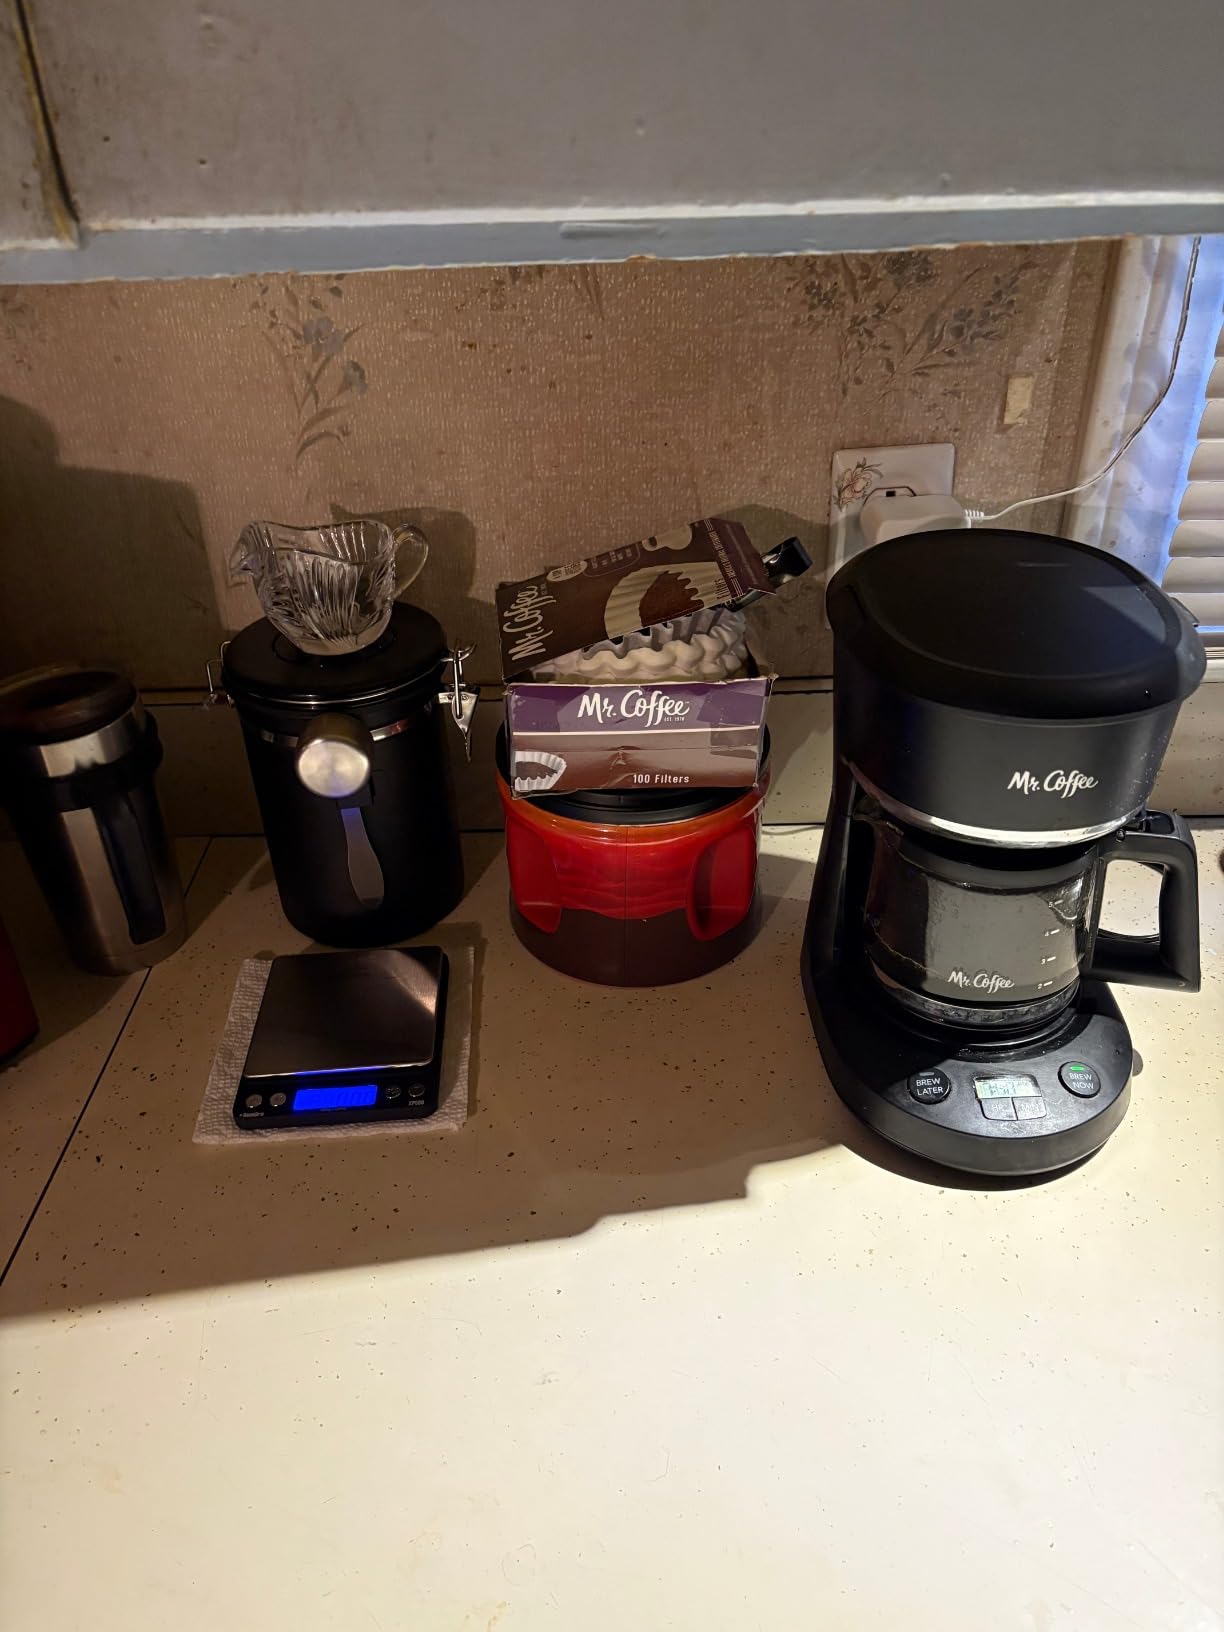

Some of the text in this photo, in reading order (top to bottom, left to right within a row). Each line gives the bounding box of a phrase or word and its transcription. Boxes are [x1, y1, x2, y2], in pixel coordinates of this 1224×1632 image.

[503, 586, 556, 661] Mr. Coffee
[577, 690, 690, 727] Mr. Coffee
[632, 773, 689, 784] 100 Filters
[1007, 770, 1098, 798] Mr. Coffee
[948, 971, 1015, 993] Mr. Coffee
[1069, 1072, 1092, 1081] BREW
[916, 1077, 941, 1088] BREW
[1072, 1080, 1094, 1090] NOW
[916, 1086, 944, 1096] LATER
